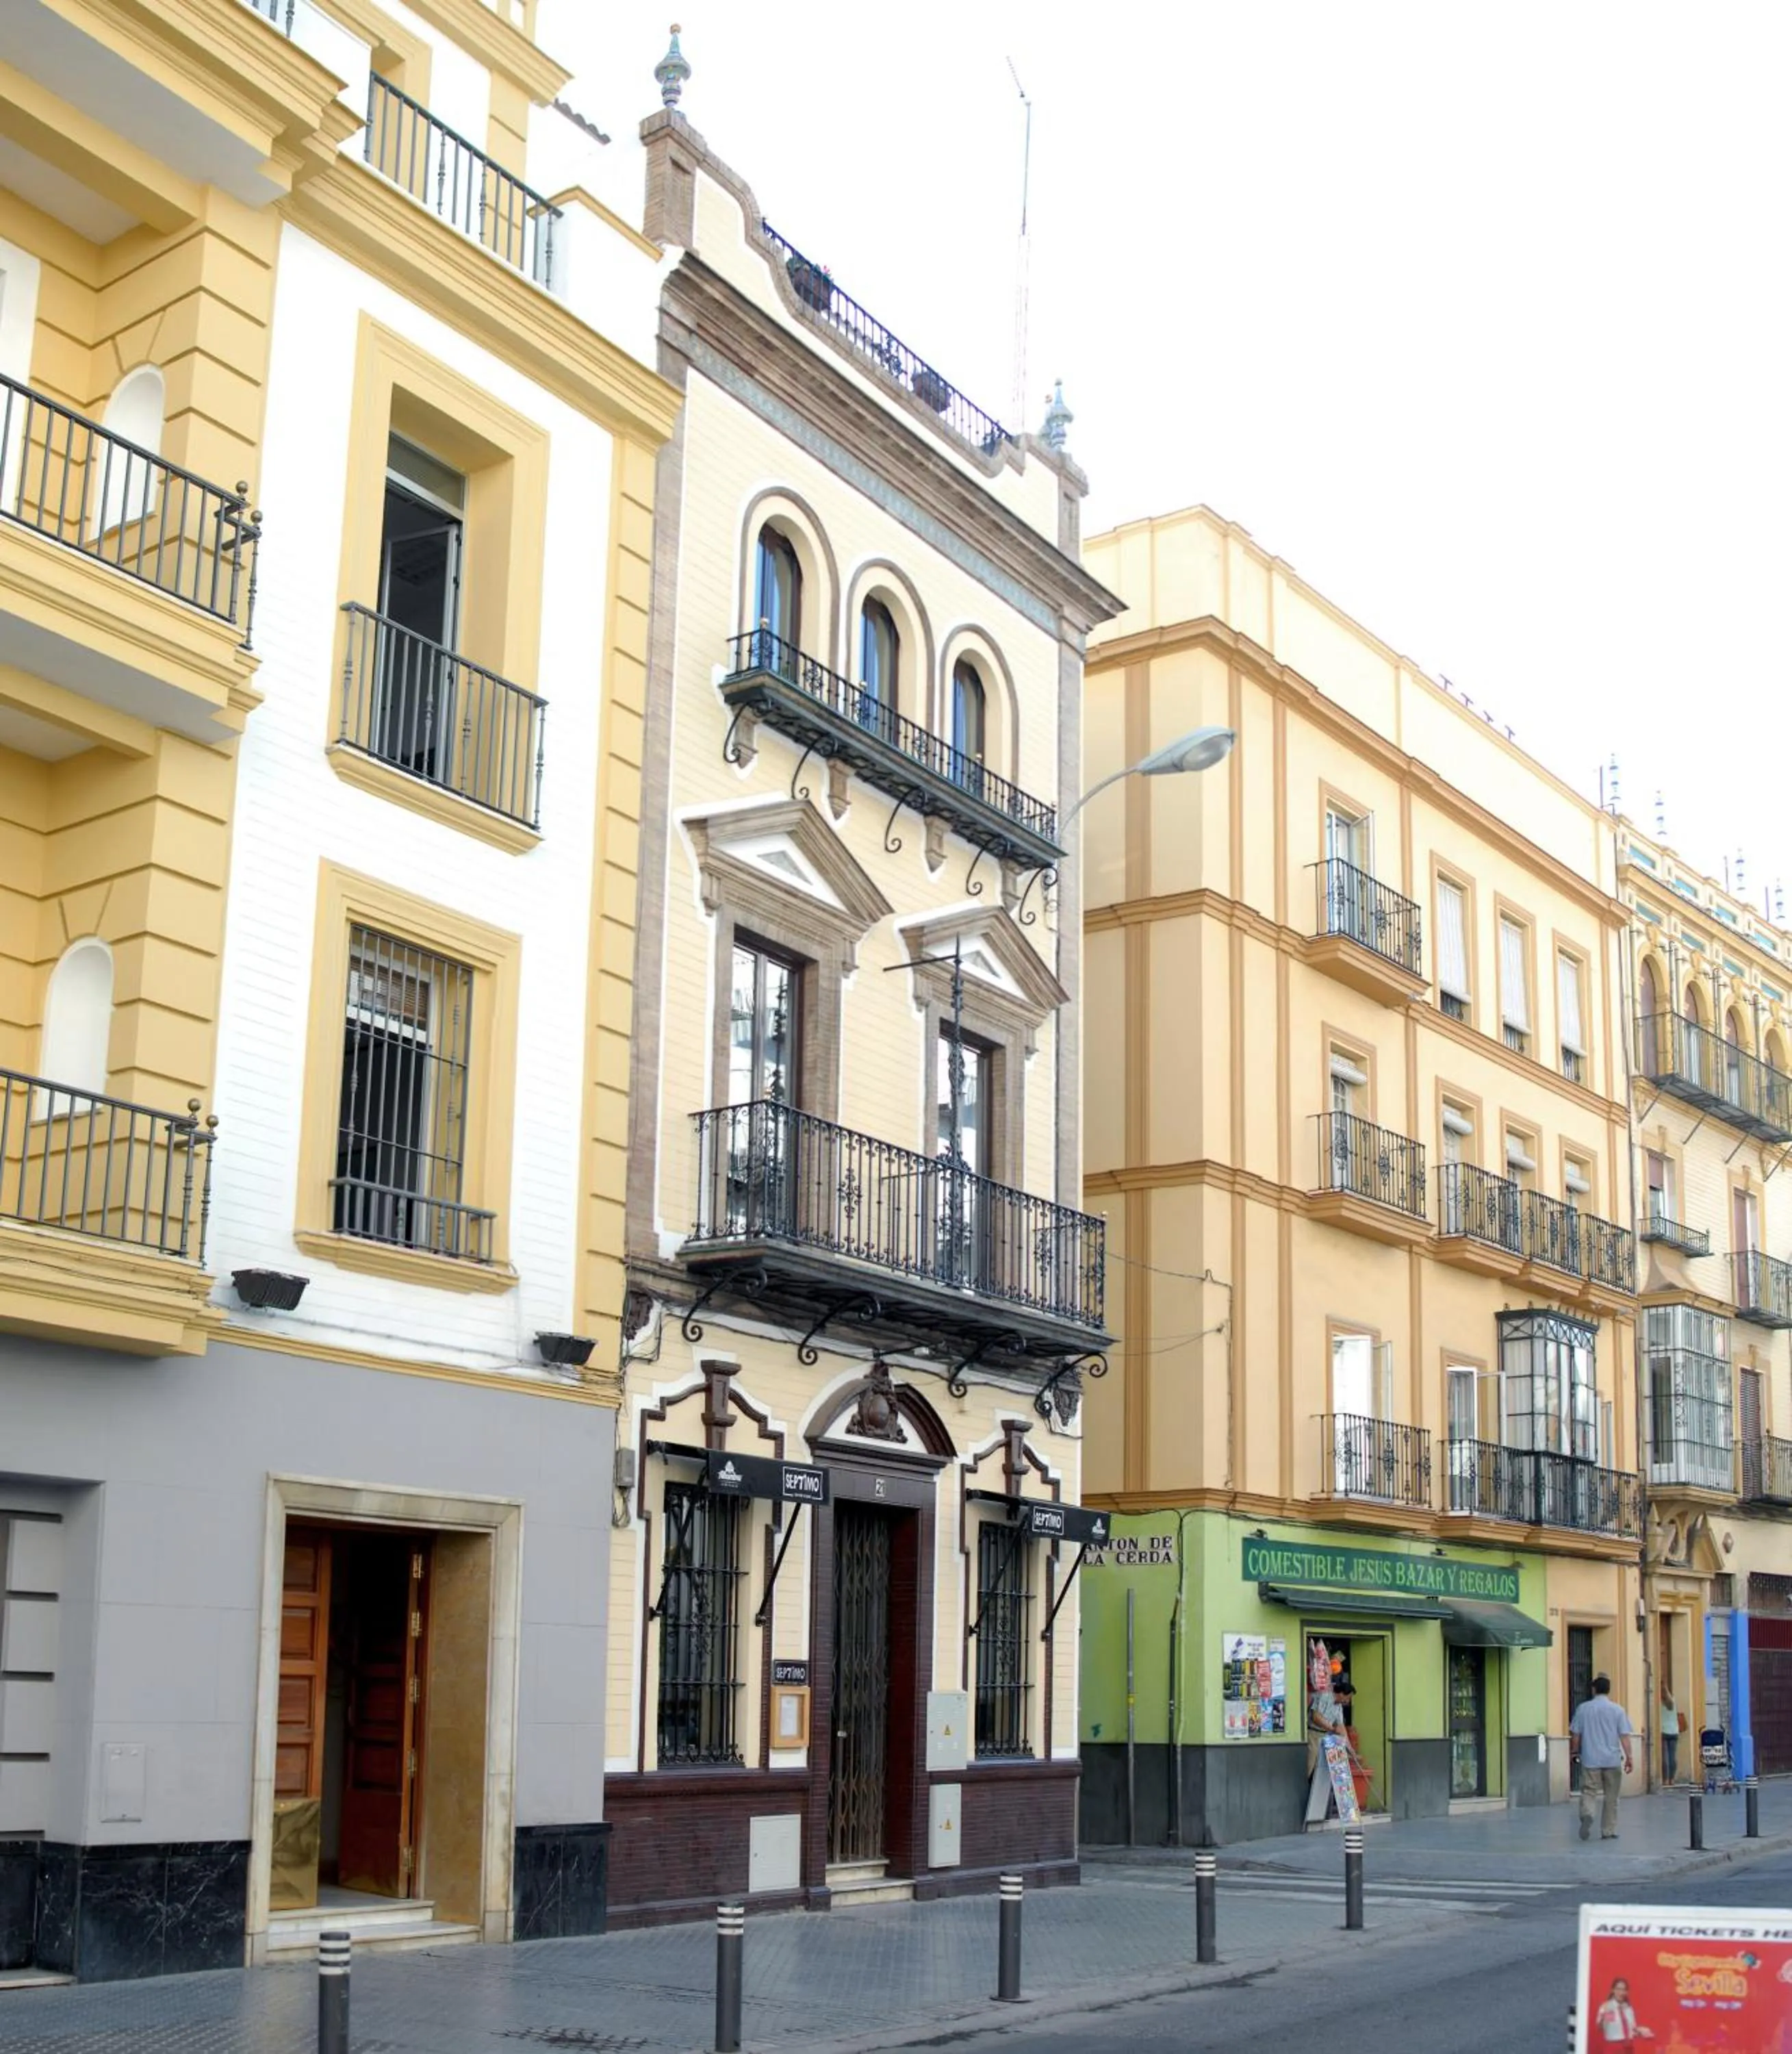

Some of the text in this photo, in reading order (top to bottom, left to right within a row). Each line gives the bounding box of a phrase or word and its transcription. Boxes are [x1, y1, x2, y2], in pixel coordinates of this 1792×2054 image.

[1150, 1536, 1173, 1549] DE
[1084, 1551, 1173, 1564] LA CERDA
[1248, 1548, 1516, 1597] COMESTIBLE JESUS BAZAR Y REGALOS
[1659, 1926, 1755, 1938] TICKETS
